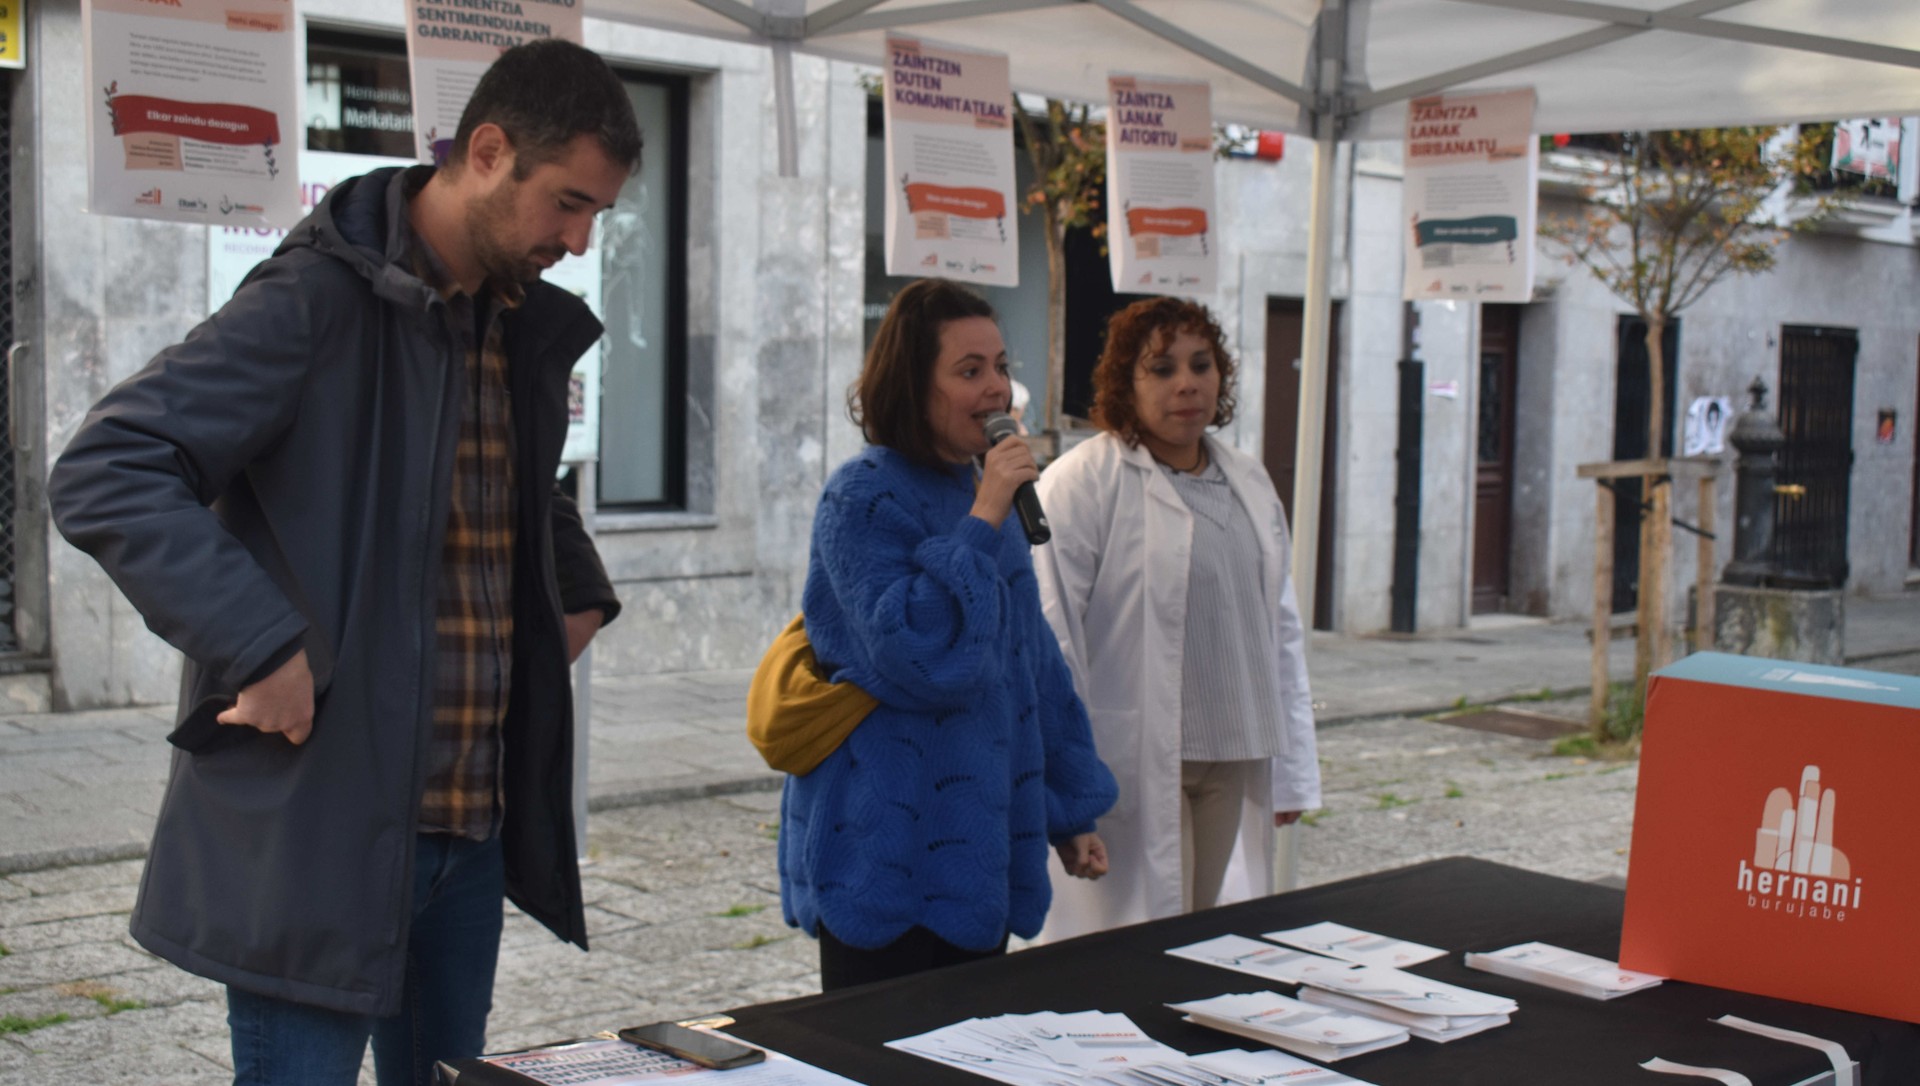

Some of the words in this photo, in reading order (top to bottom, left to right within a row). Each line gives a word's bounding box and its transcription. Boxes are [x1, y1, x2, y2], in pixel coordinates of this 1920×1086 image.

[417, 7, 551, 36] SENTIMENDUAREN
[418, 24, 523, 47] GARRANTZIAZ
[893, 52, 962, 77] ZAINTZEN
[894, 71, 942, 91] DUTEN
[346, 84, 410, 105] Hernaniko
[895, 89, 1007, 118] KOMUNITATEAK
[1117, 90, 1175, 110] ZAINTZA
[146, 110, 172, 121] Elkar
[173, 114, 207, 127] zaindu
[207, 117, 250, 132] dezagun
[1118, 110, 1163, 127] LANAK
[1412, 105, 1478, 122] ZAINTZA
[1120, 129, 1178, 147] AITORTU
[1410, 124, 1461, 139] LANAK
[1410, 138, 1497, 157] BIRBANATU
[1737, 860, 1862, 909] hernani
[1748, 893, 1846, 922] burujabe
